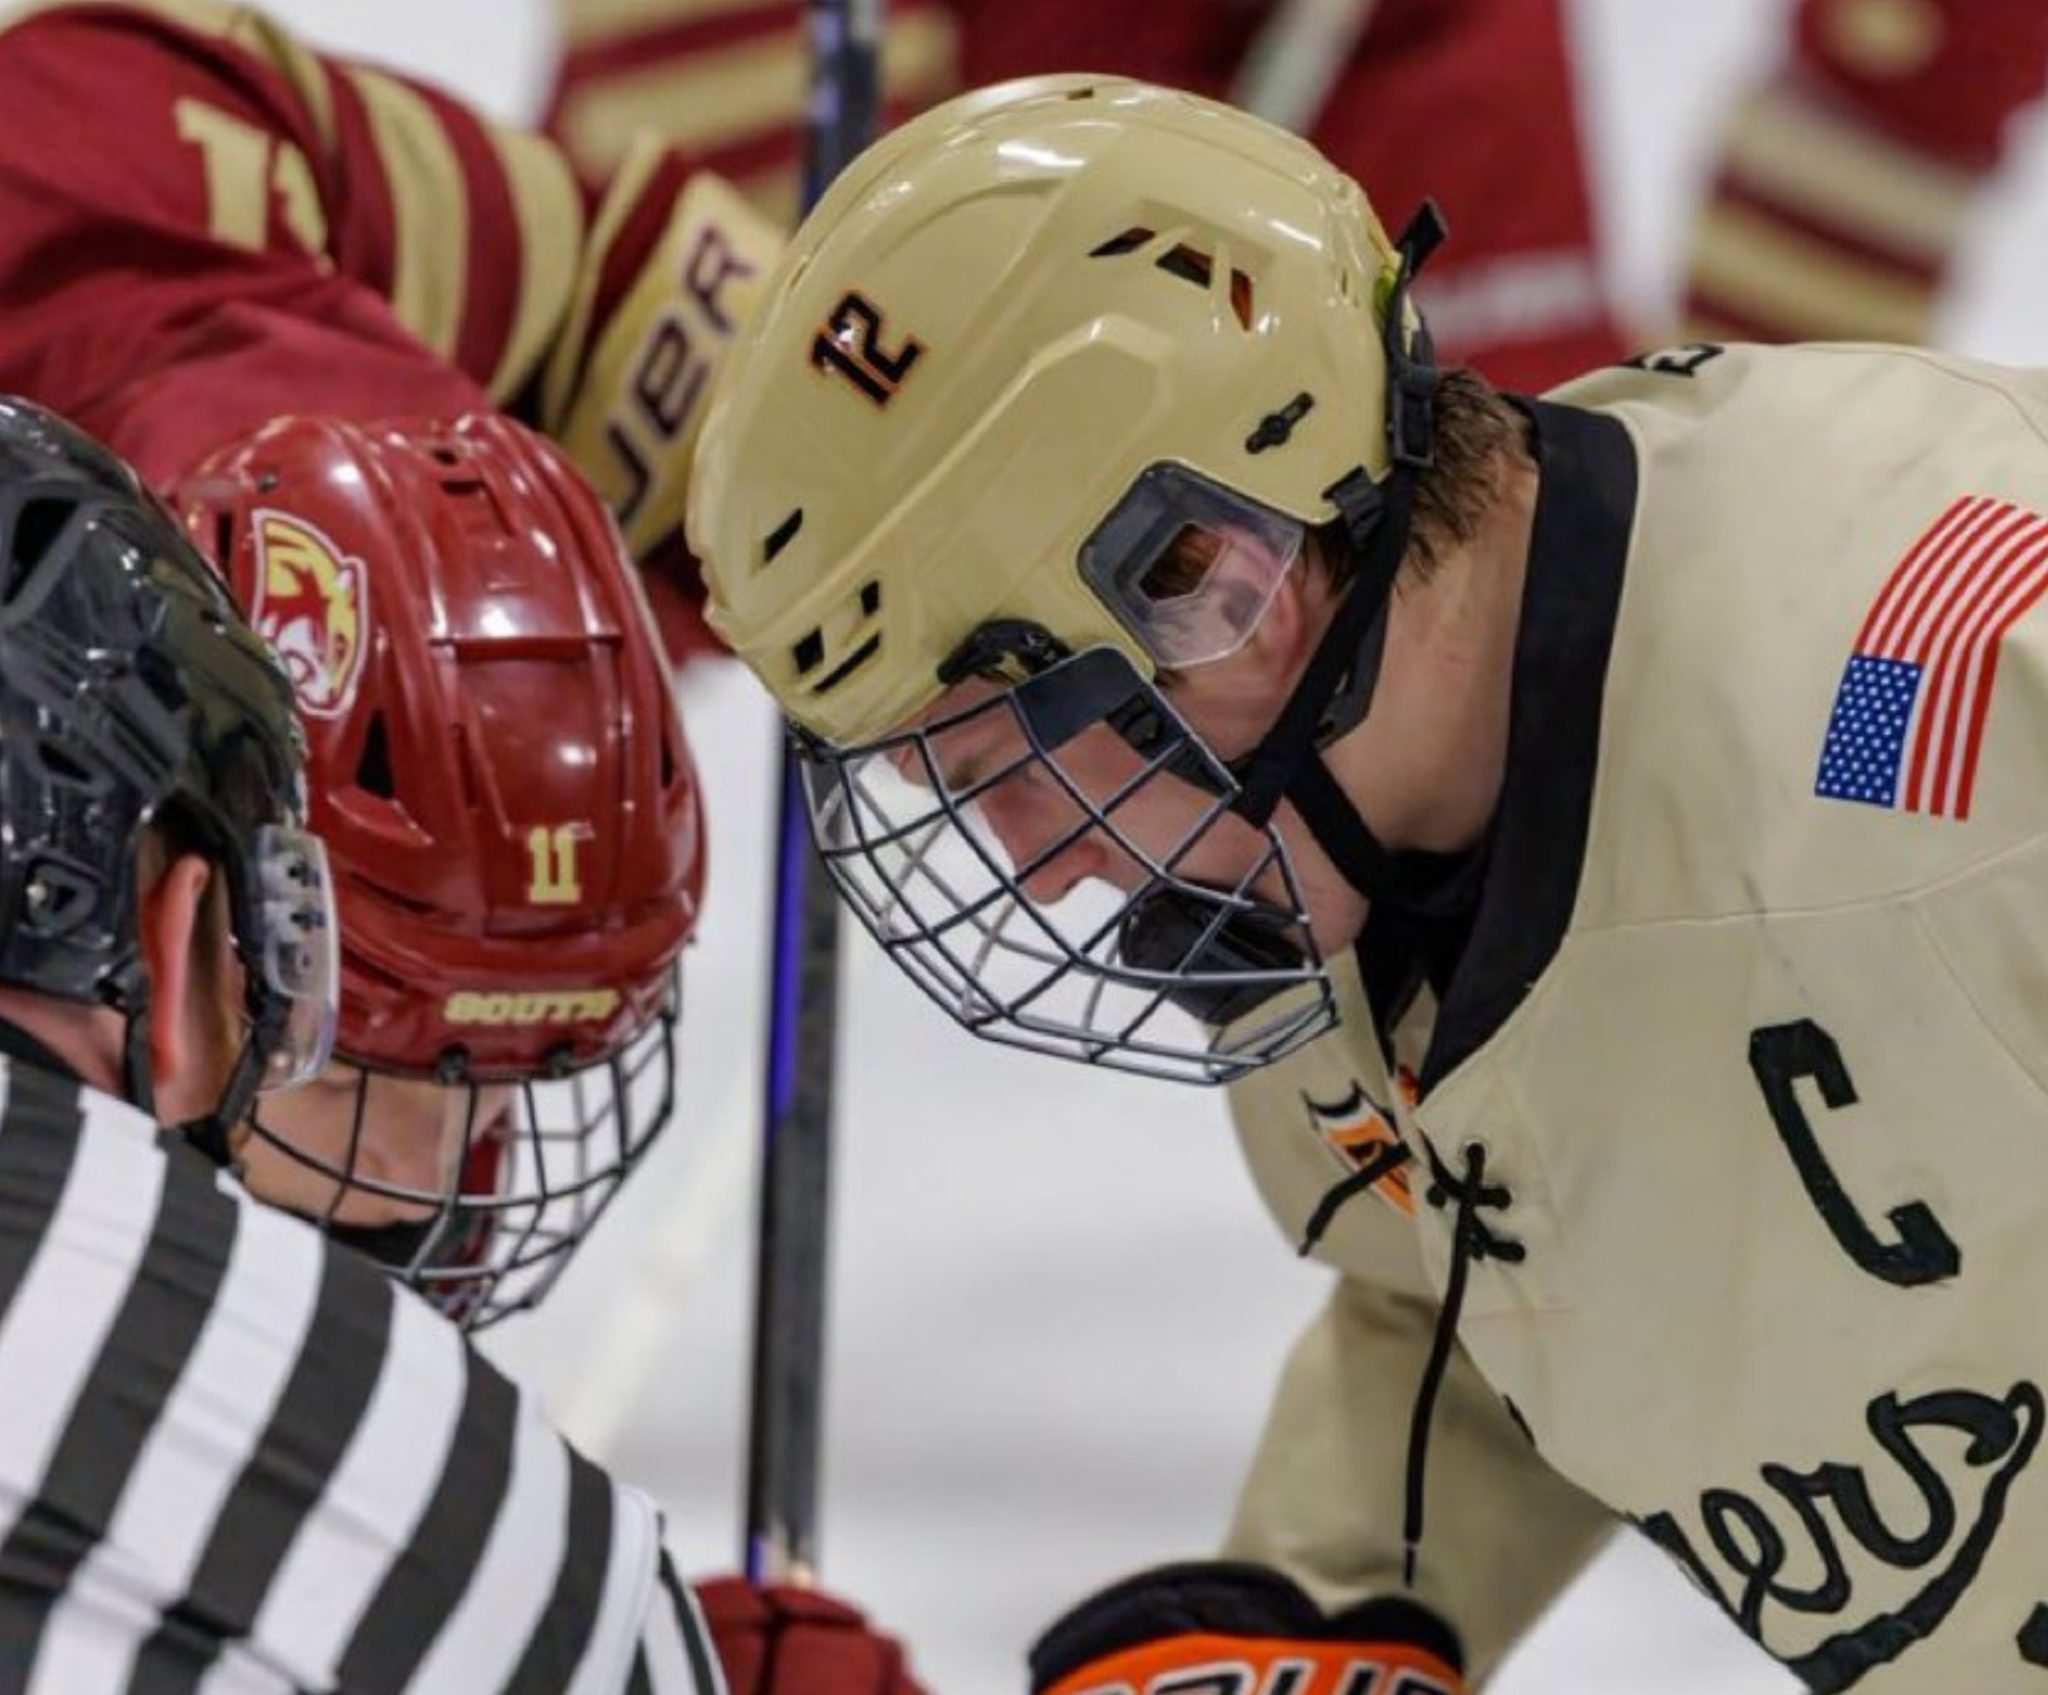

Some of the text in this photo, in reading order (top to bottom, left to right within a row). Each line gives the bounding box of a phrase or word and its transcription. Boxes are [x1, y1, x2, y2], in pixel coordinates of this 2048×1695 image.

[808, 288, 924, 408] 12
[529, 826, 582, 903] 11
[444, 988, 620, 1024] SOUTH
[1749, 1018, 1961, 1288] C
[1640, 1388, 2018, 1642] ers
